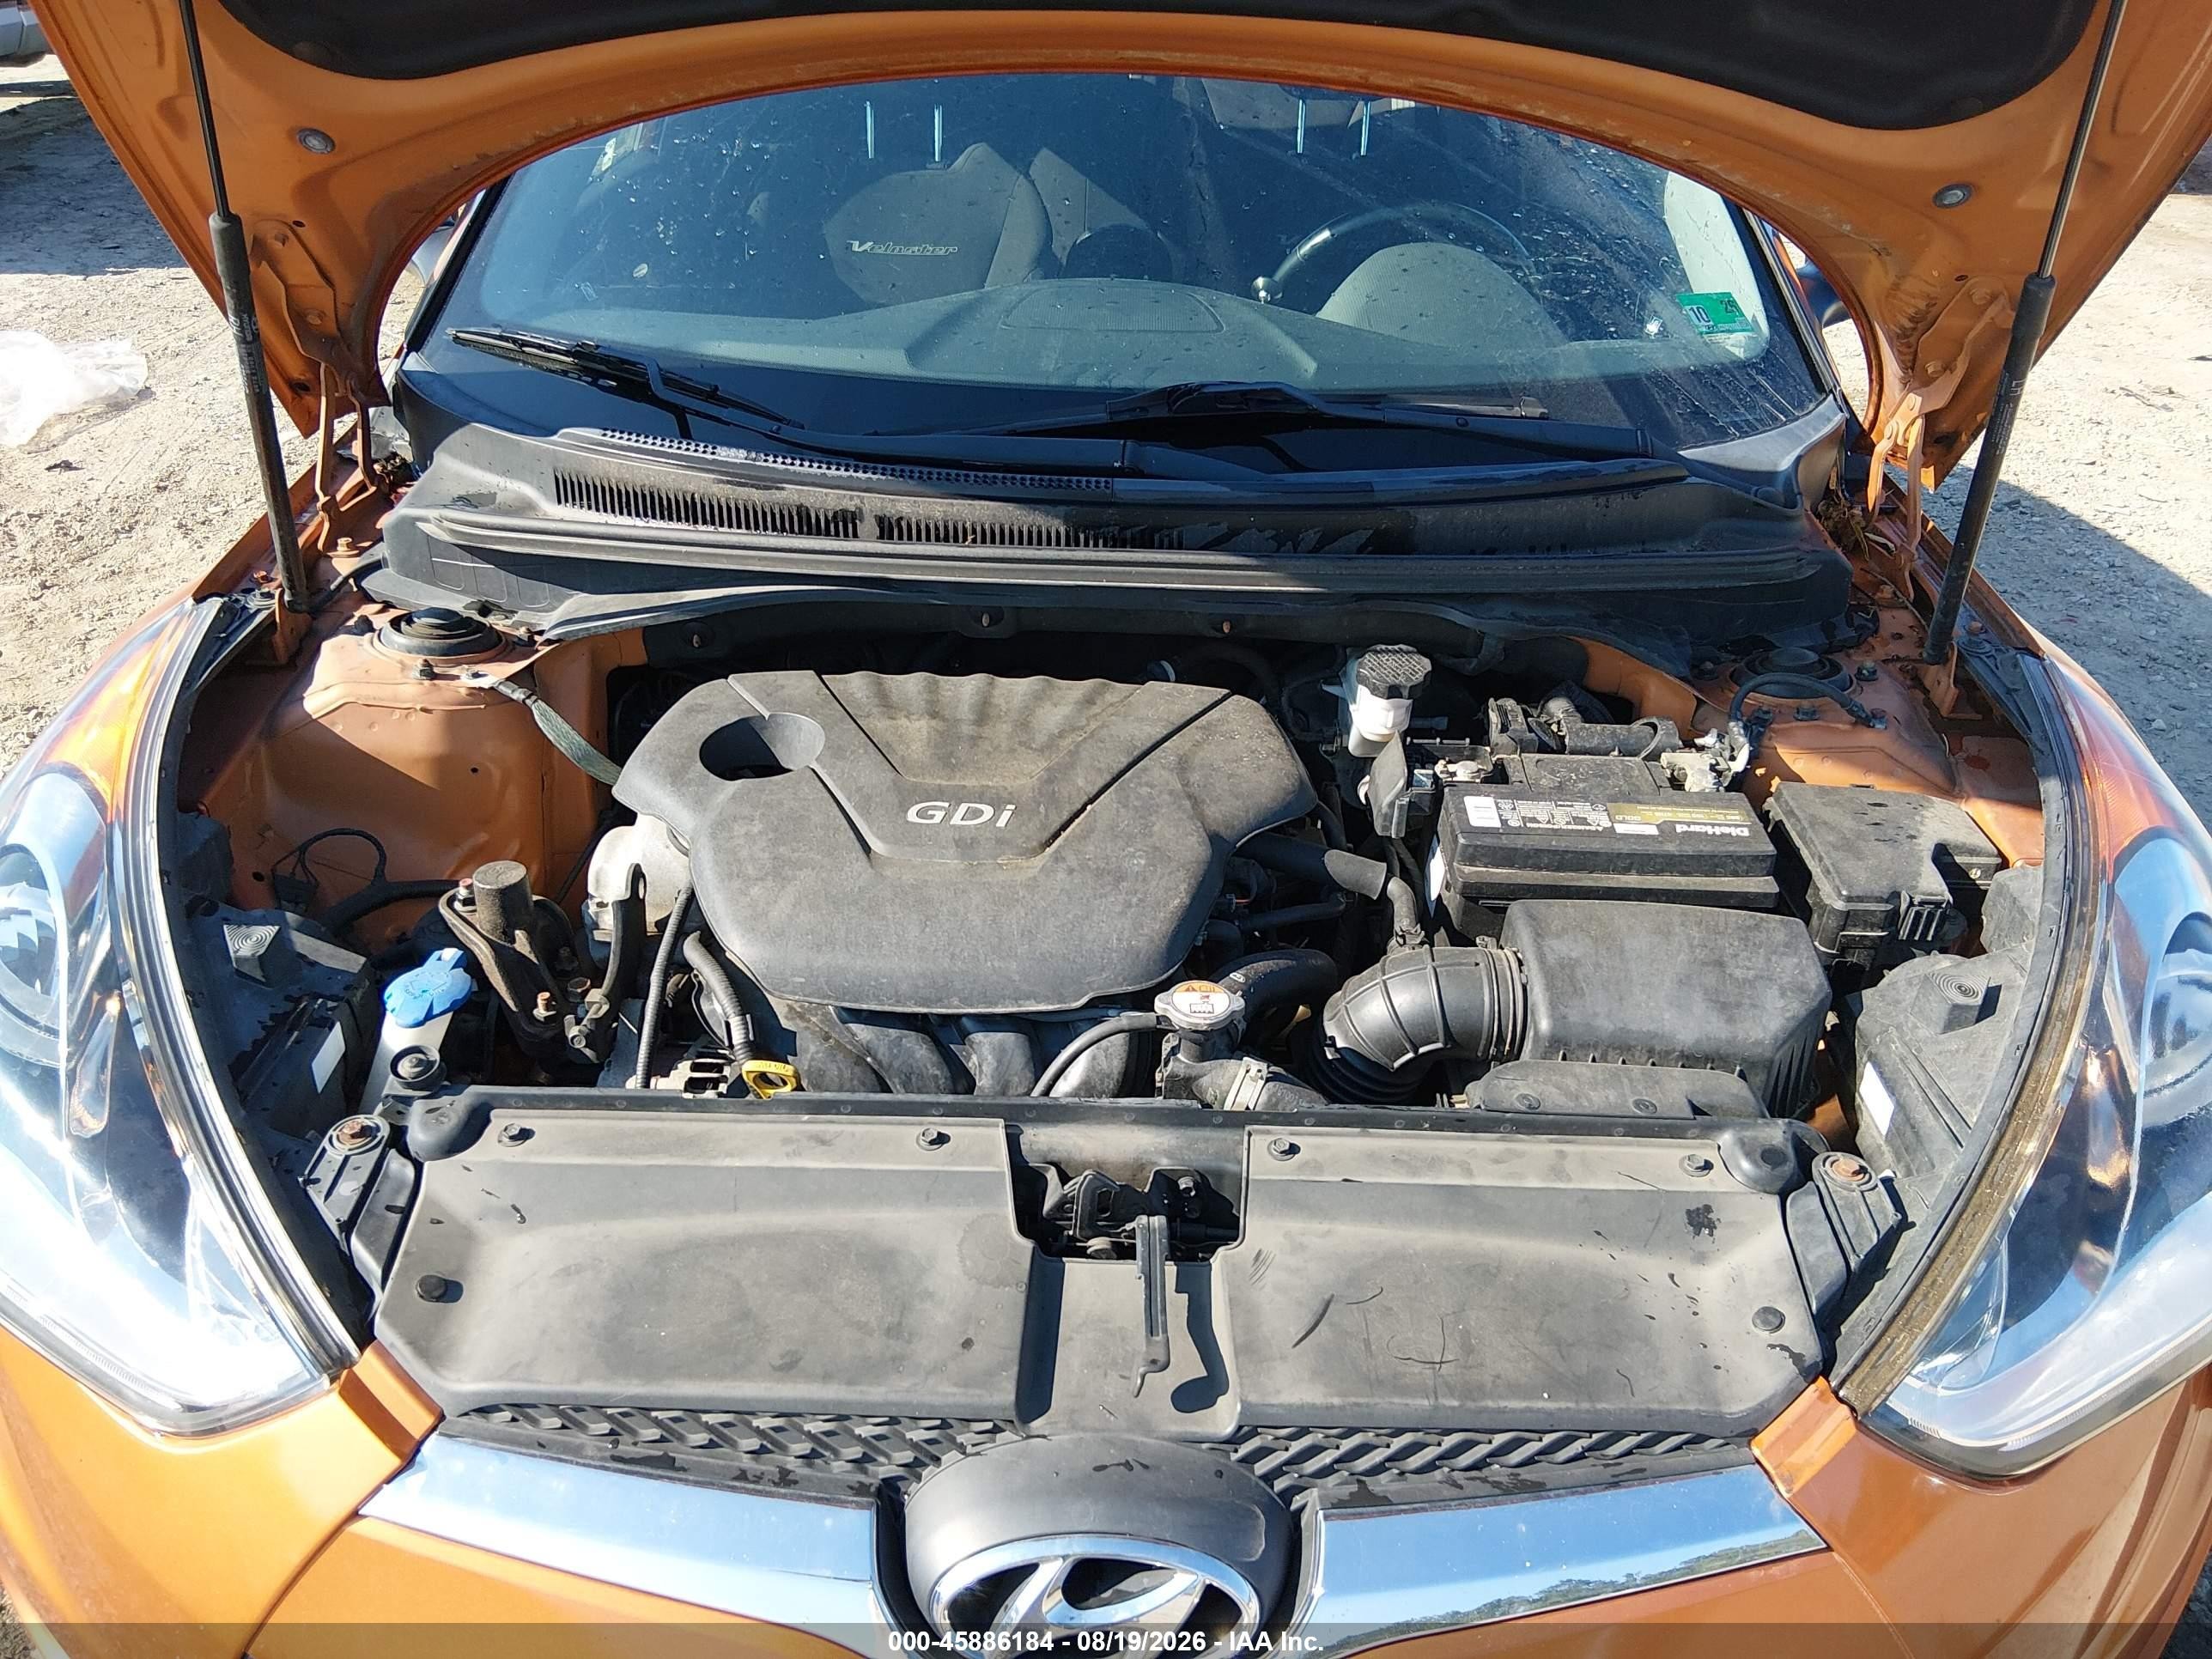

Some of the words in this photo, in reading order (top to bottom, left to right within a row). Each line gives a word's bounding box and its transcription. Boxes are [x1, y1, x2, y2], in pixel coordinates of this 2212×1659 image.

[847, 240, 958, 255] Veloster
[1688, 306, 1711, 323] 10
[2010, 380, 2027, 395] LH
[906, 801, 1017, 827] GDi
[1675, 824, 1749, 836] DieHard
